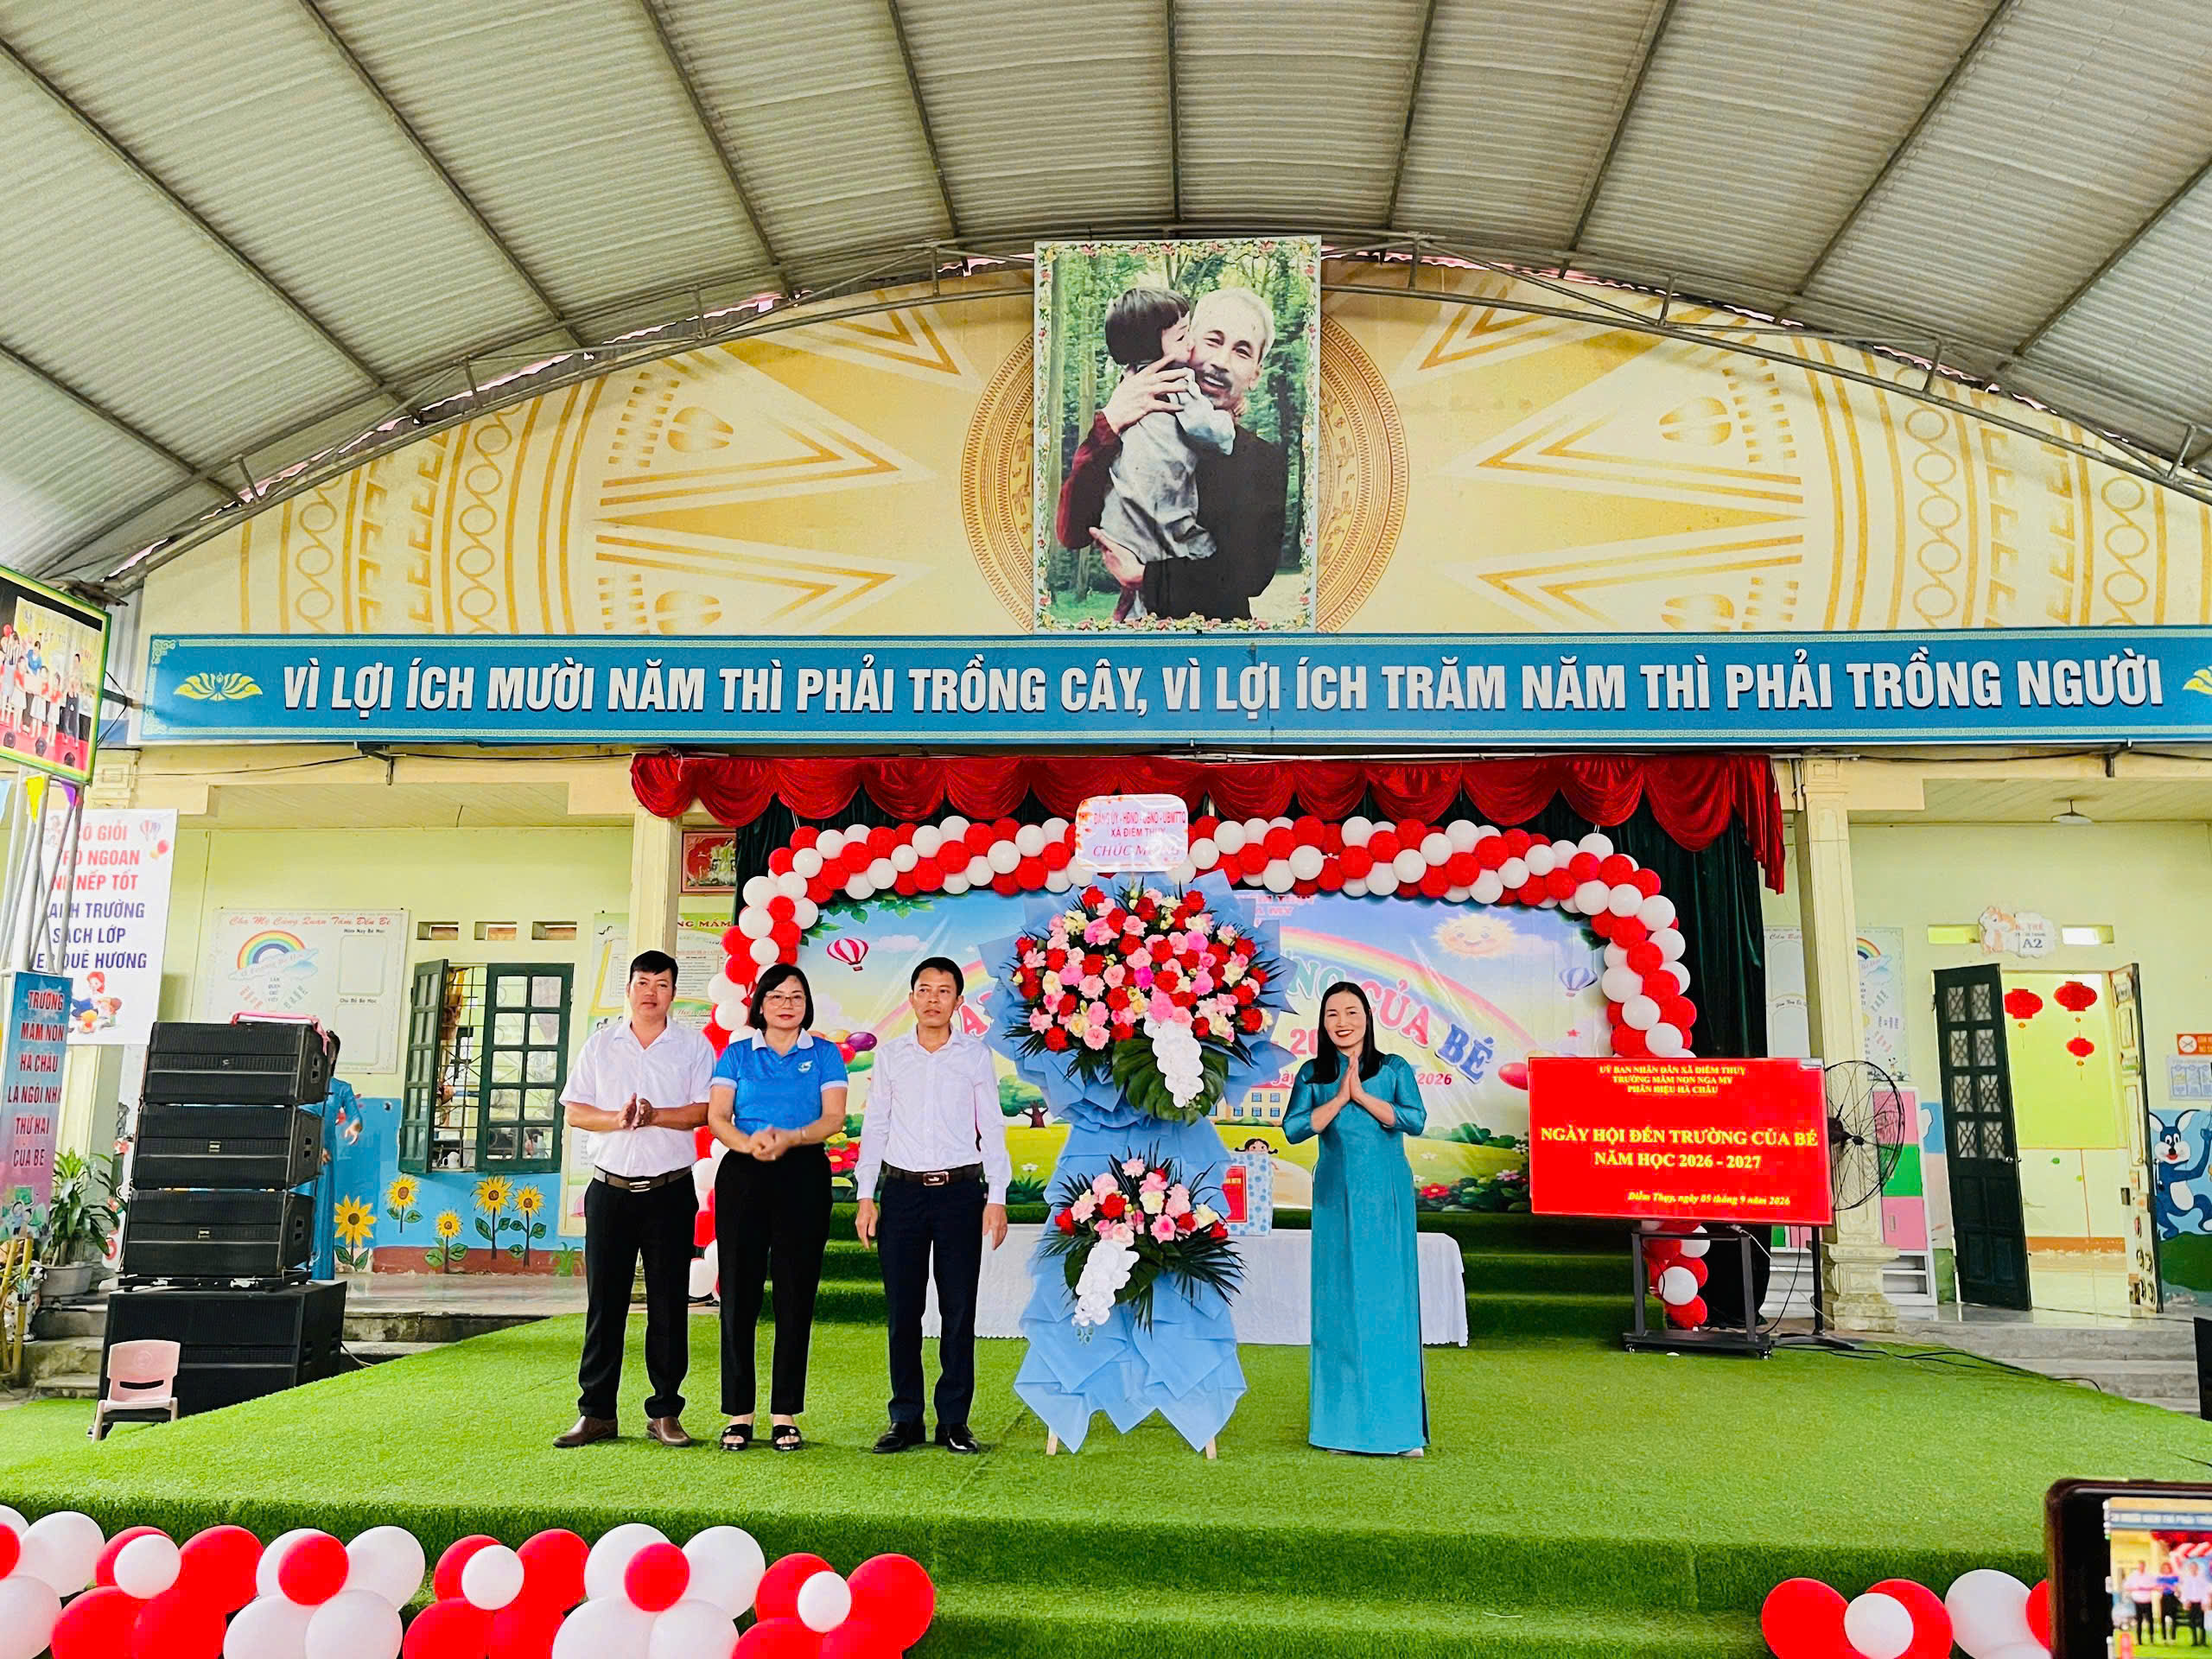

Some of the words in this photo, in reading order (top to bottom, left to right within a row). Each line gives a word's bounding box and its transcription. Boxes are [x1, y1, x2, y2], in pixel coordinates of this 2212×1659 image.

[284, 658, 320, 709] VÌ
[331, 662, 394, 718] LỢI
[405, 658, 474, 709] ÍCH
[486, 658, 595, 710] MƯỜI
[607, 658, 706, 710] NĂM
[720, 660, 782, 711] THÌ
[796, 653, 894, 712] PHẢI
[908, 653, 1046, 712] TRỒNG
[1060, 658, 1148, 716] CÂY,
[1162, 657, 1201, 710] VÌ
[1216, 660, 1281, 719] LỢI
[1296, 656, 1367, 710] ÍCH
[1381, 656, 1505, 710] TRĂM
[1522, 655, 1626, 710] NĂM
[1641, 655, 1711, 709] THÌ
[1726, 648, 1833, 709] PHẢI
[1847, 646, 2003, 709] TRỒNG
[2018, 648, 2164, 707] NGƯỜI
[97, 818, 129, 841] GIỎI
[87, 849, 140, 865] NGOAN
[1093, 842, 1133, 857] CHÚC
[76, 868, 107, 891] NẾP
[112, 868, 139, 891] TỐT
[86, 899, 145, 919] TRƯỜNG
[98, 924, 127, 944] LỚP
[2022, 938, 2043, 949] A2
[95, 951, 148, 969] HƯƠNG
[1434, 1023, 1496, 1084] BÉ
[1417, 1072, 1452, 1085] 2026
[35, 1116, 49, 1135] HAI
[1541, 1124, 1590, 1141] NGÀY
[1592, 1127, 1625, 1145] HỘI
[1629, 1124, 1666, 1143] ĐẾN
[1669, 1126, 1747, 1145] TRƯỜNG
[1751, 1127, 1791, 1146] CỦA
[1794, 1128, 1819, 1147] BÉ
[1594, 1149, 1634, 1166] NĂM
[1637, 1153, 1676, 1169] HỌC
[1679, 1154, 1713, 1168] 2026
[1726, 1155, 1764, 1169] 2027
